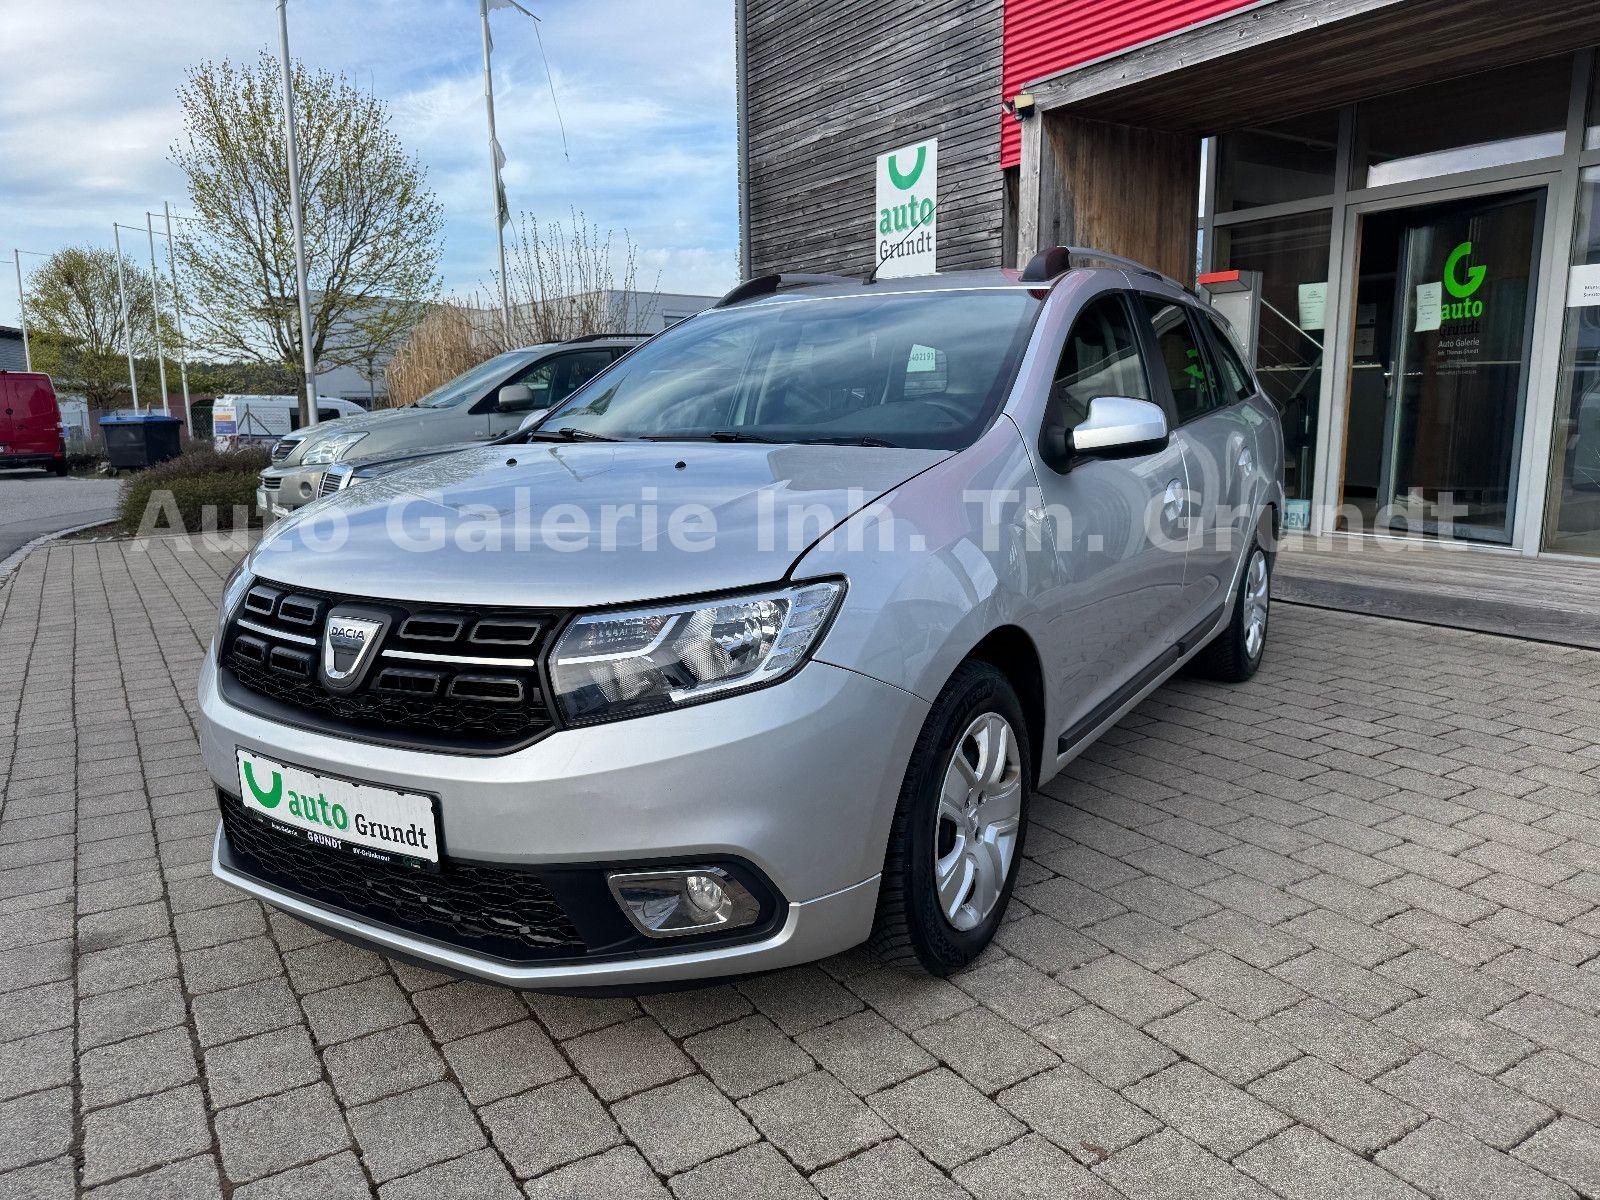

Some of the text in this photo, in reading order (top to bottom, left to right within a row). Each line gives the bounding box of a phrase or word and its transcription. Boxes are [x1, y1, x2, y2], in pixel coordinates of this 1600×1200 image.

[879, 194, 935, 236] auto
[879, 231, 932, 261] Grundt
[1440, 298, 1483, 321] auto
[1438, 337, 1480, 348] Auto Galerie
[331, 626, 365, 640] DACIA
[287, 789, 349, 831] auto
[307, 831, 342, 850] GRUNDT
[355, 813, 429, 849] Grundt
